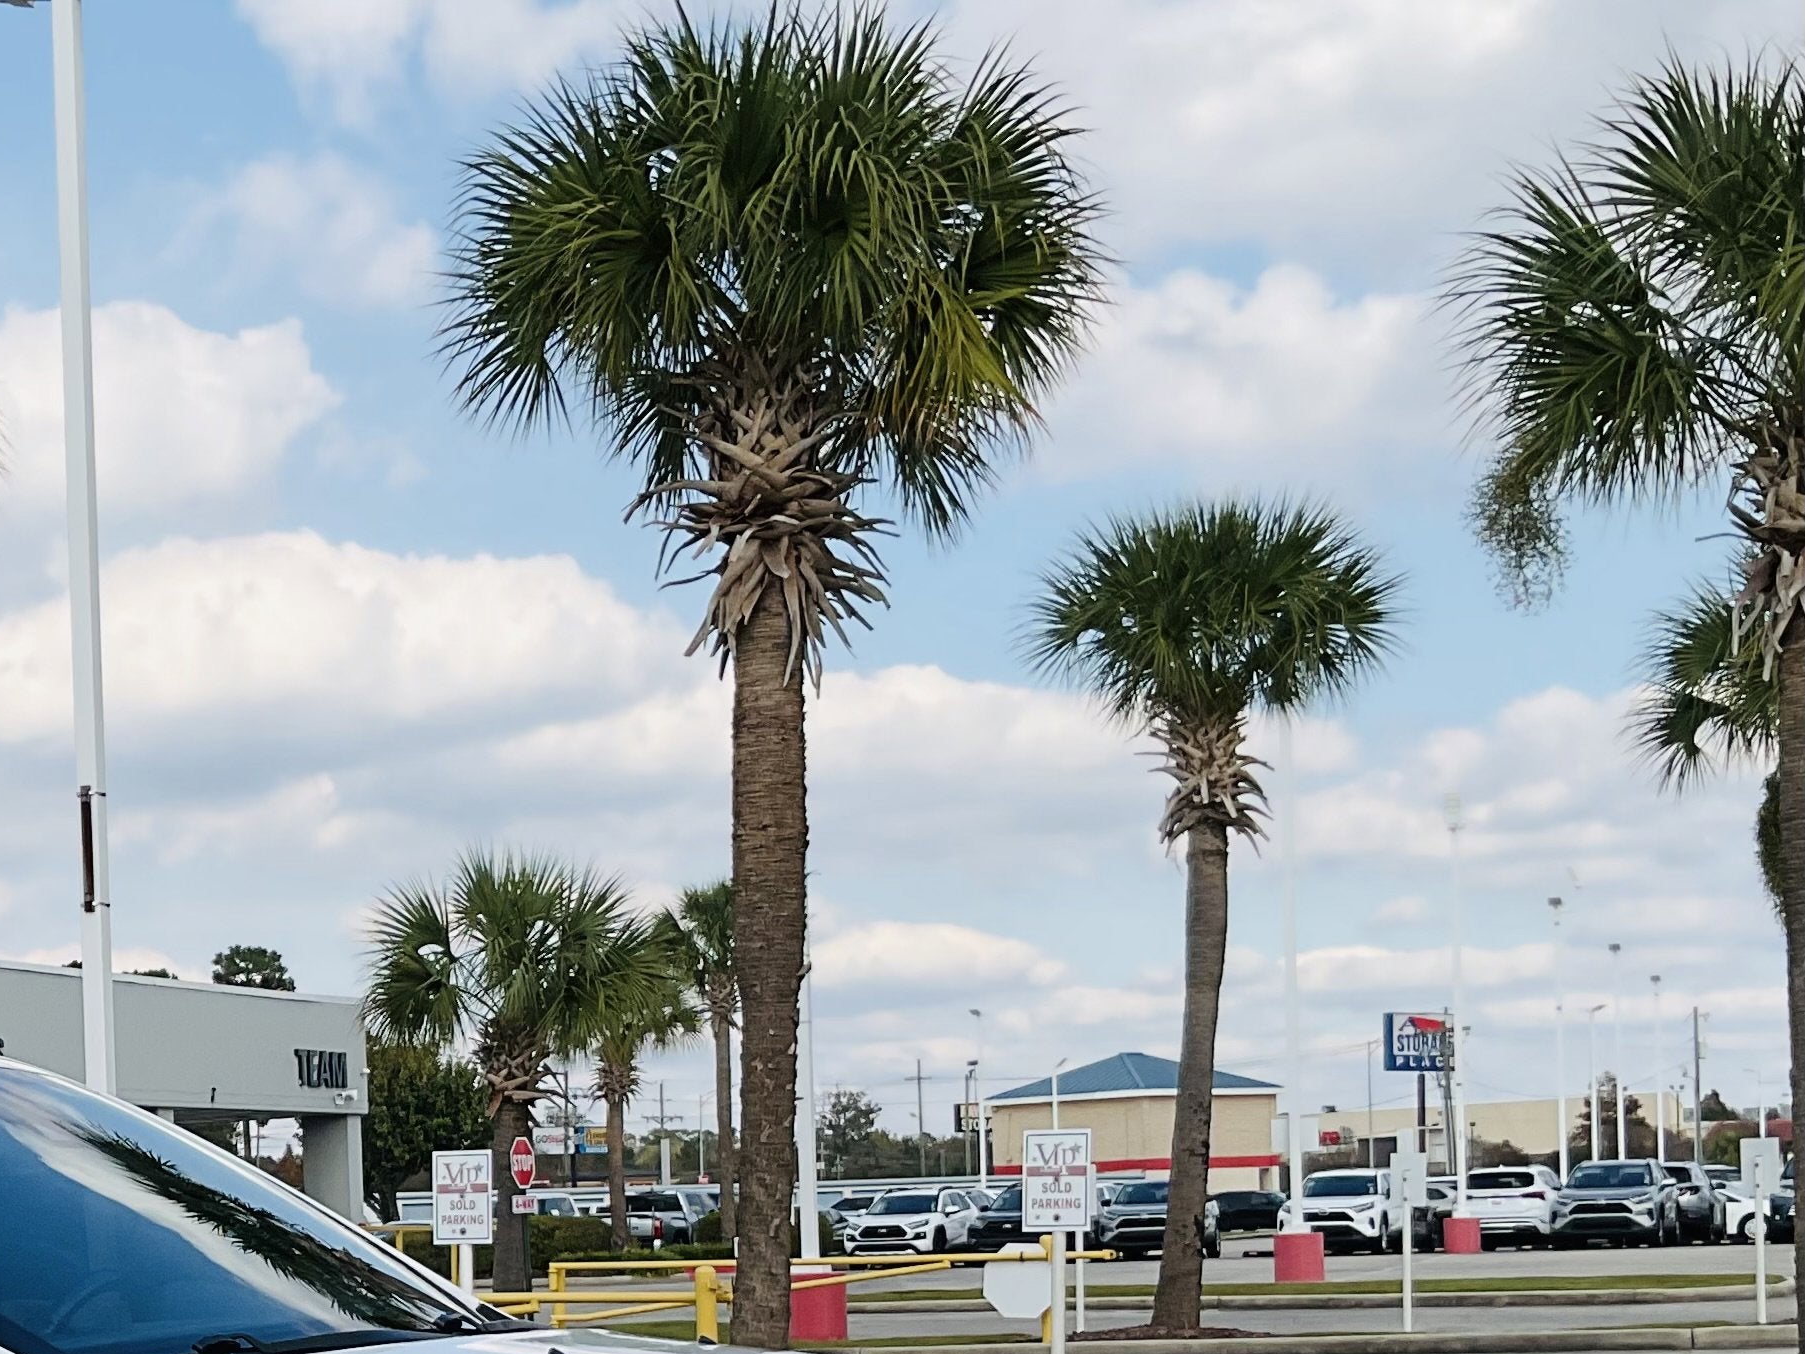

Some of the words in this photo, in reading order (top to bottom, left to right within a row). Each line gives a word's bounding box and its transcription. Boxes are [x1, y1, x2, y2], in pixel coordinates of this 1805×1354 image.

[294, 1049, 348, 1088] TEAM
[513, 1154, 533, 1171] STOP
[1042, 1182, 1072, 1193] SOLD
[449, 1200, 476, 1210] SOLD
[1031, 1198, 1081, 1209] PARKING
[441, 1214, 484, 1225] PARKING
